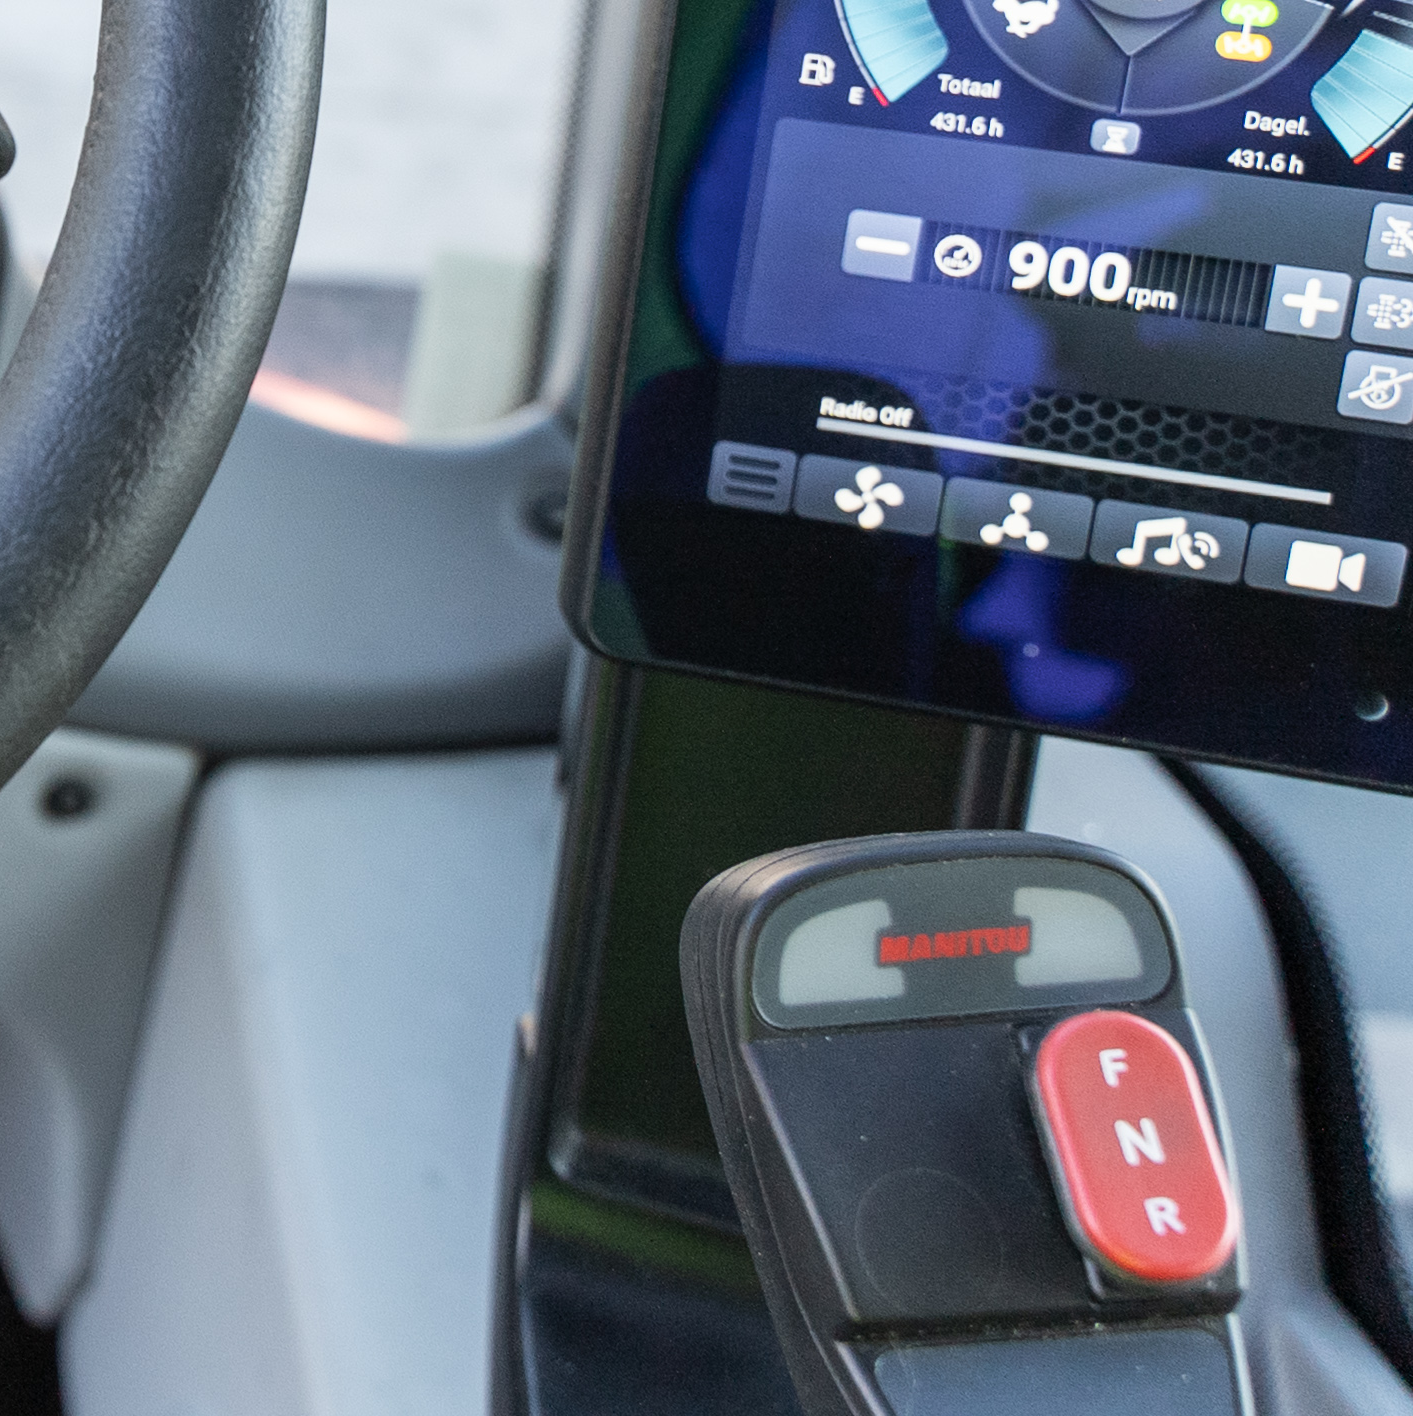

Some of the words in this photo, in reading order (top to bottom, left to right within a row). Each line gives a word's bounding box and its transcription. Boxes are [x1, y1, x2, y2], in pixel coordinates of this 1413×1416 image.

[847, 85, 866, 106] E
[937, 72, 1002, 100] Totaal
[929, 111, 986, 137] 431.6
[1243, 109, 1311, 137] Dagel.
[1226, 148, 1286, 174] 431.6
[1386, 151, 1406, 172] E
[1008, 239, 1132, 303] 900
[1126, 286, 1178, 311] rpm
[819, 395, 878, 424] Radio
[879, 404, 915, 428] Off
[879, 923, 1031, 964] MANITOU
[1098, 1048, 1128, 1087] F
[1113, 1118, 1166, 1167] N
[1143, 1196, 1186, 1235] R
